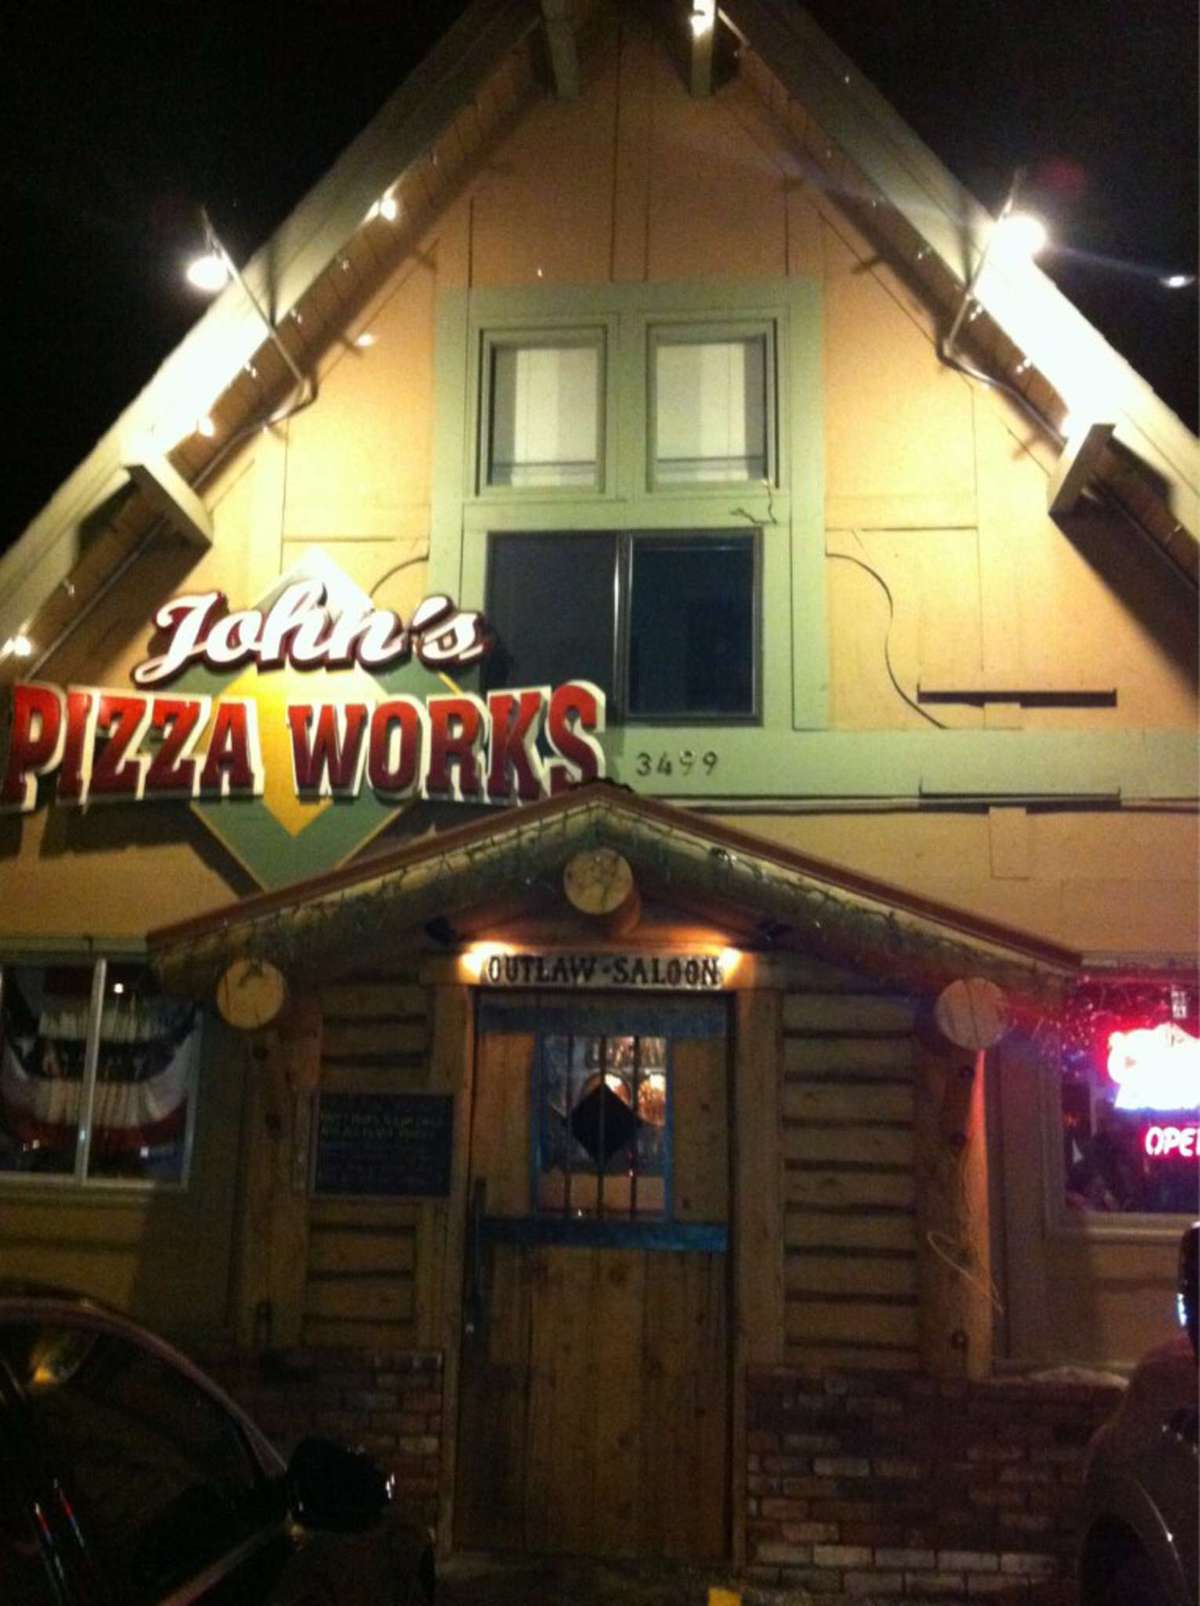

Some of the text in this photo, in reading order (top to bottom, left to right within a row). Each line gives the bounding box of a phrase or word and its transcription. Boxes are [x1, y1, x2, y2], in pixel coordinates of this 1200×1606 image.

[135, 581, 483, 686] John's
[3, 681, 606, 808] PIZZA WORKS
[637, 751, 718, 776] 3499
[488, 956, 719, 987] OUTLAW SALOON
[1145, 1126, 1200, 1157] OPE
